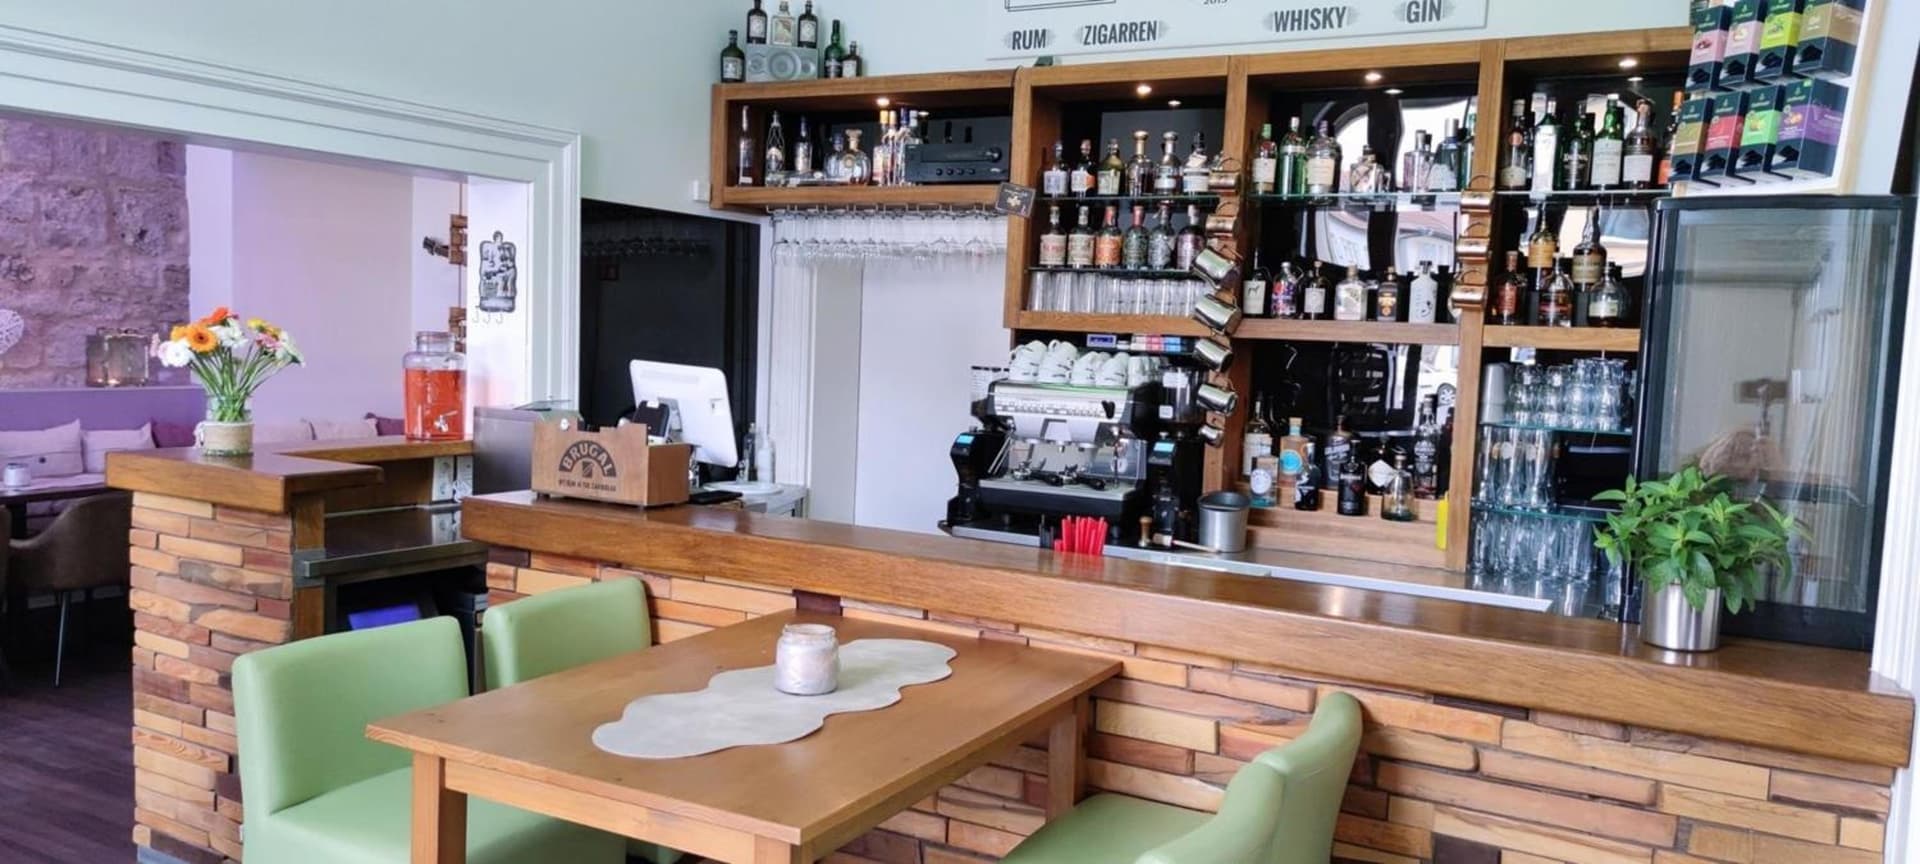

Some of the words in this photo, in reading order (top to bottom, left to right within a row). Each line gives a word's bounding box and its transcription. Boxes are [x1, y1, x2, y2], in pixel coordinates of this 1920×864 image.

[1274, 6, 1347, 33] WHISKY
[1406, 0, 1442, 24] GIN
[1012, 28, 1047, 50] RUM
[1083, 20, 1158, 46] ZIGARREN
[562, 441, 614, 477] BRUGAL
